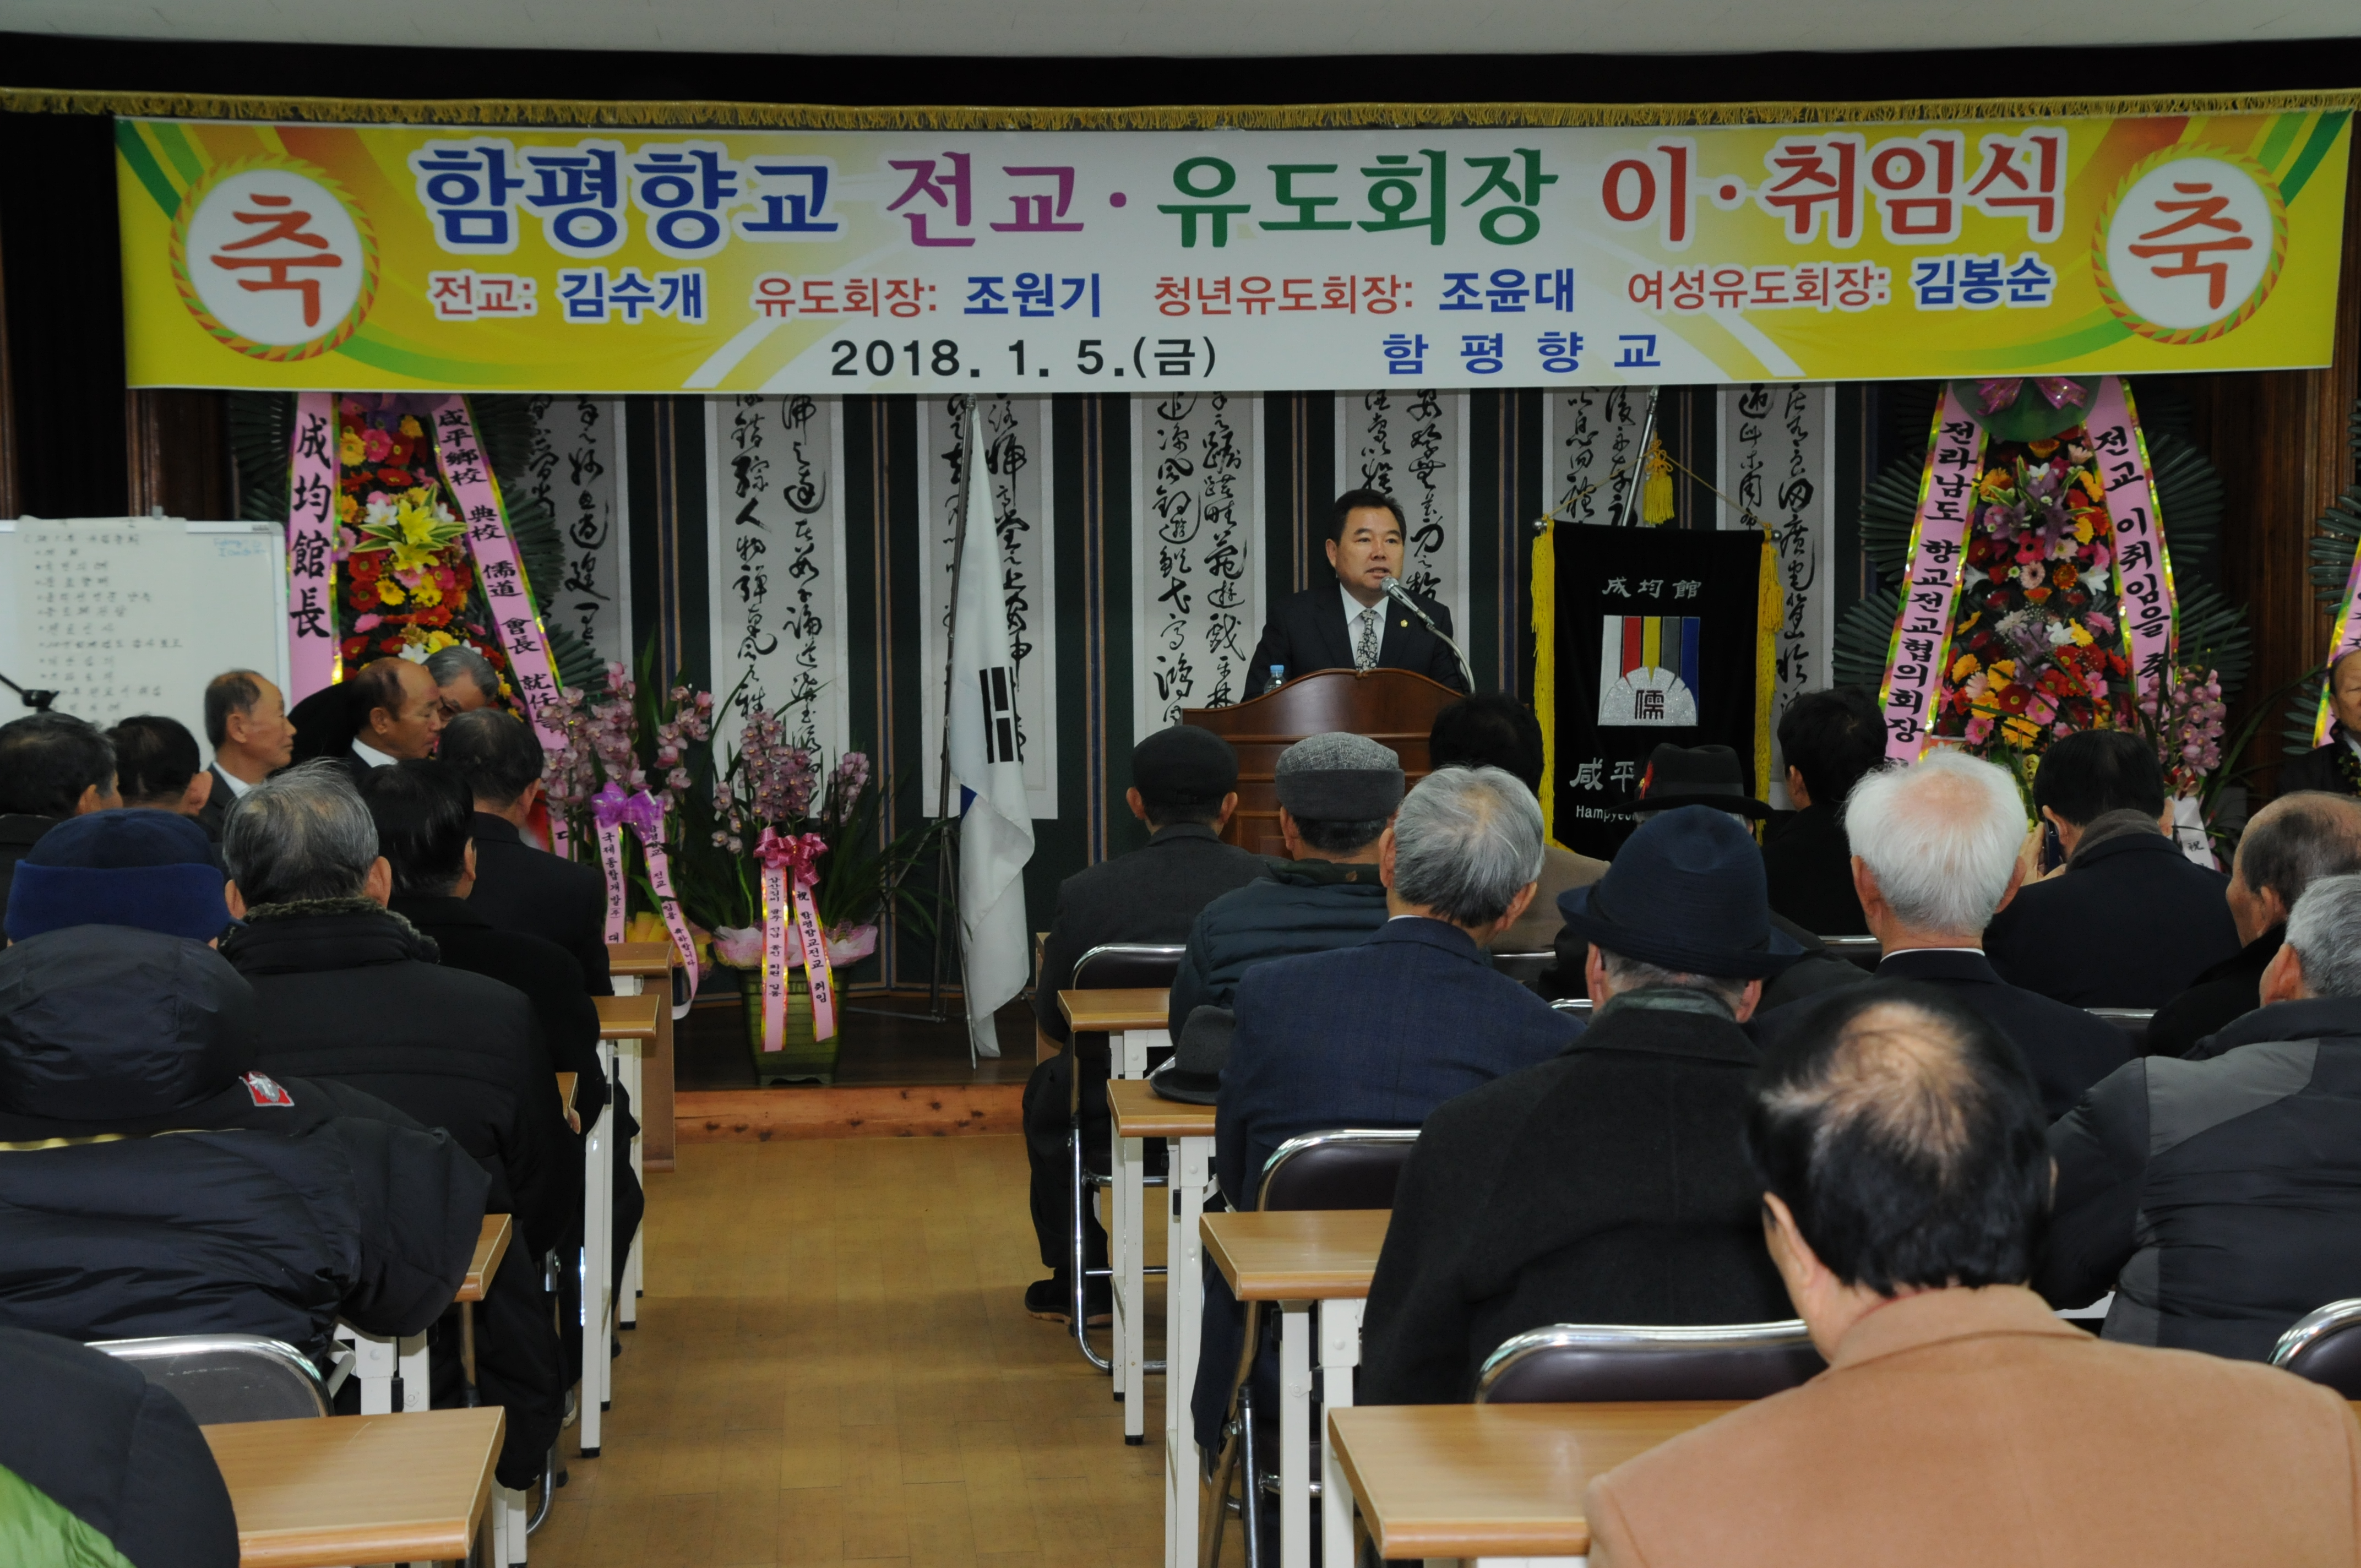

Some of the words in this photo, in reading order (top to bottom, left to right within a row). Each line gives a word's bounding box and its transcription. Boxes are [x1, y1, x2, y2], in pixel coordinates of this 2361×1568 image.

[419, 147, 839, 250] 함평향교
[2128, 182, 2254, 310] 축
[210, 193, 342, 328] 축
[433, 276, 531, 314] 전교:
[562, 272, 702, 319] 김수개
[755, 278, 935, 317] 유도회장:
[964, 272, 1101, 318] 조원기
[1154, 275, 1412, 316] 청년유도회장:
[1439, 268, 1575, 314] 조윤대
[1628, 266, 1885, 309] 여성유도회장:
[1915, 257, 2052, 306] 김봉순
[831, 339, 980, 378] 2018.
[1008, 340, 1048, 378] 1.
[1924, 421, 1977, 523] 전라남도
[2093, 426, 2146, 492] 전교
[290, 413, 331, 638] 成均館長
[2115, 507, 2171, 638] 이취임을
[1602, 576, 1702, 599] 成均館
[1886, 538, 1962, 743] 향교전교협의회장
